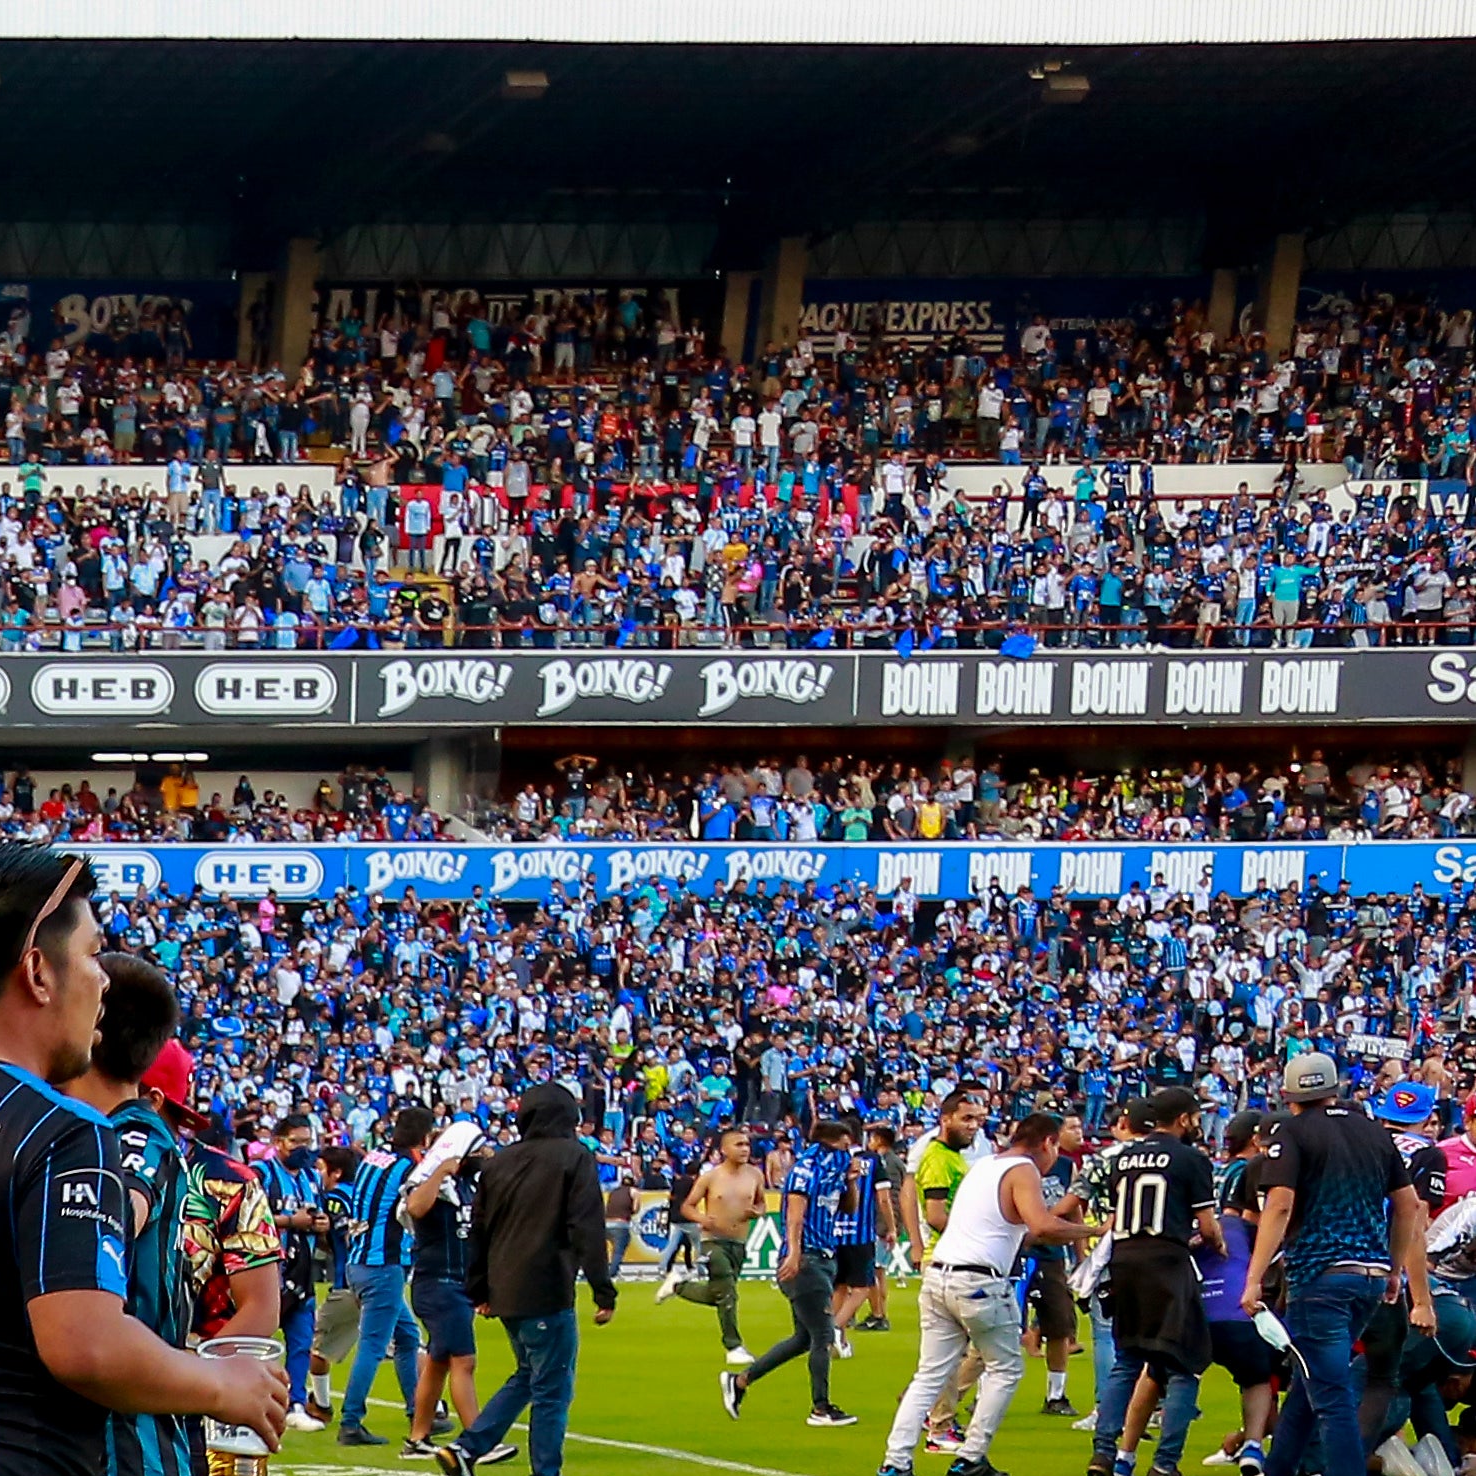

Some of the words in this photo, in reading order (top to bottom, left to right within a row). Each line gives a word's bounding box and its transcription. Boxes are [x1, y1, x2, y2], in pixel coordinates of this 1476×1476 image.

[378, 659, 514, 718] BOING!
[536, 660, 673, 718] BOING!
[697, 660, 835, 718] BOING!
[882, 662, 959, 716] BOHN
[976, 662, 1053, 716] BOHN
[1070, 661, 1147, 715] BOHN
[1165, 660, 1243, 715] BOHN
[1260, 660, 1339, 715] BOHN
[365, 851, 468, 894] BOING!
[490, 850, 594, 894] BOING!
[607, 850, 710, 894] BOING!
[725, 850, 828, 892] BOING!
[878, 852, 941, 895] BOHN
[969, 852, 1032, 889] BOHN
[1060, 851, 1123, 895] BOHN
[1152, 851, 1214, 893] BOHN
[1242, 850, 1306, 893] BOHN
[1118, 1153, 1170, 1171] GALLO
[1113, 1173, 1167, 1241] 10
